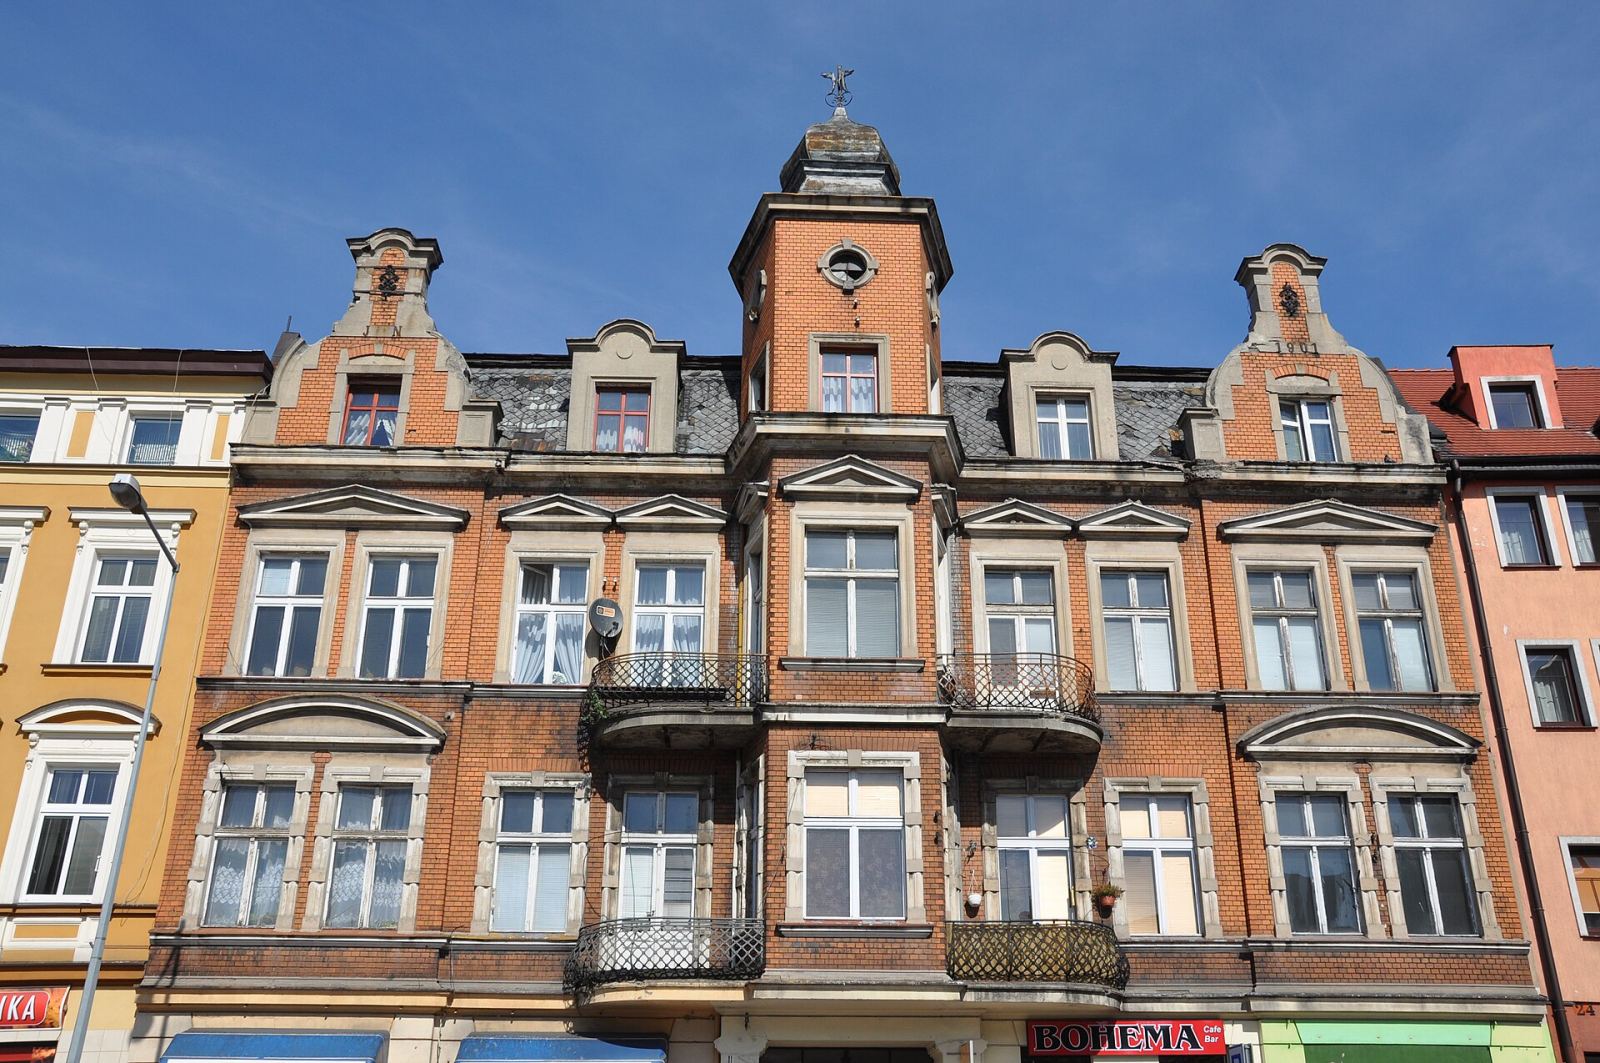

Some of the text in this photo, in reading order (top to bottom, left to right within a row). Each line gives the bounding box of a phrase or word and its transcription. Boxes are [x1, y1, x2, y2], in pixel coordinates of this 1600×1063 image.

[1274, 342, 1319, 355] 1901
[1575, 1004, 1596, 1016] 24
[1203, 1025, 1222, 1033] Cafe
[1033, 1023, 1204, 1051] BOHEMA
[1204, 1035, 1219, 1043] Bar
